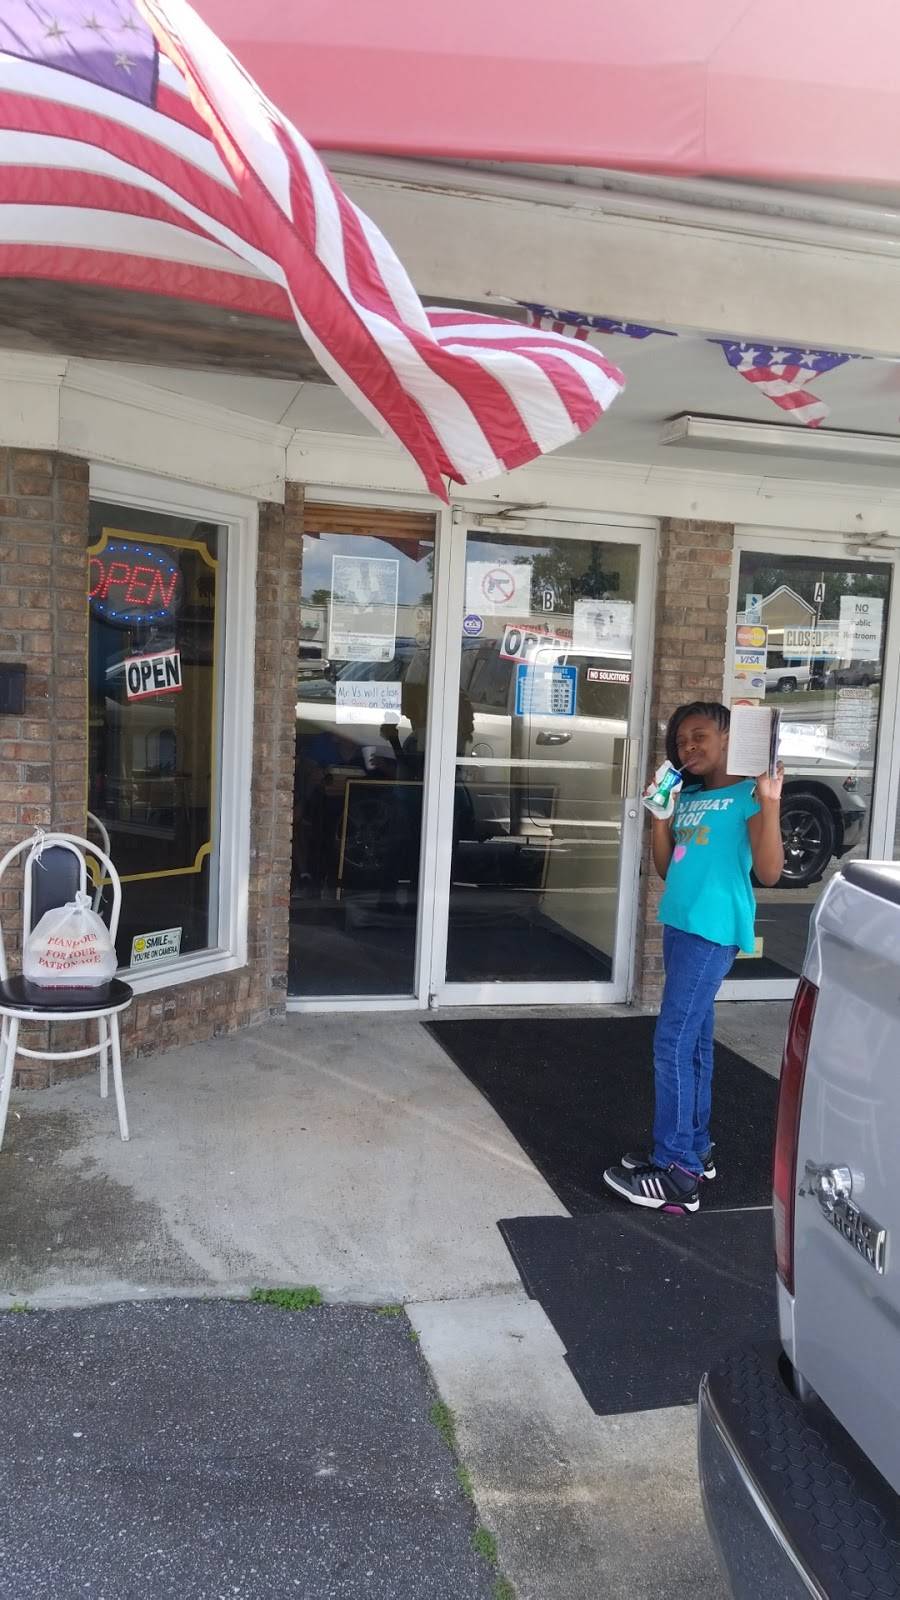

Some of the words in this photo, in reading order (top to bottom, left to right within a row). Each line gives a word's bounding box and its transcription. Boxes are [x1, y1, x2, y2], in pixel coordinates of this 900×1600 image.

[88, 558, 179, 607] OPEN
[815, 583, 824, 600] A
[545, 592, 553, 609] B
[855, 604, 869, 613] NO
[786, 630, 822, 647] CLOSED
[740, 655, 760, 664] VISA
[127, 656, 180, 693] OPEN
[590, 671, 599, 680] NO
[599, 671, 630, 681] SOLICITORS
[688, 798, 734, 812] WHAT
[675, 811, 706, 827] YOU
[146, 935, 168, 949] SMILE
[46, 949, 67, 960] FOR
[69, 947, 96, 959] YOUR
[151, 950, 158, 958] ON
[159, 946, 178, 957] CAMERA
